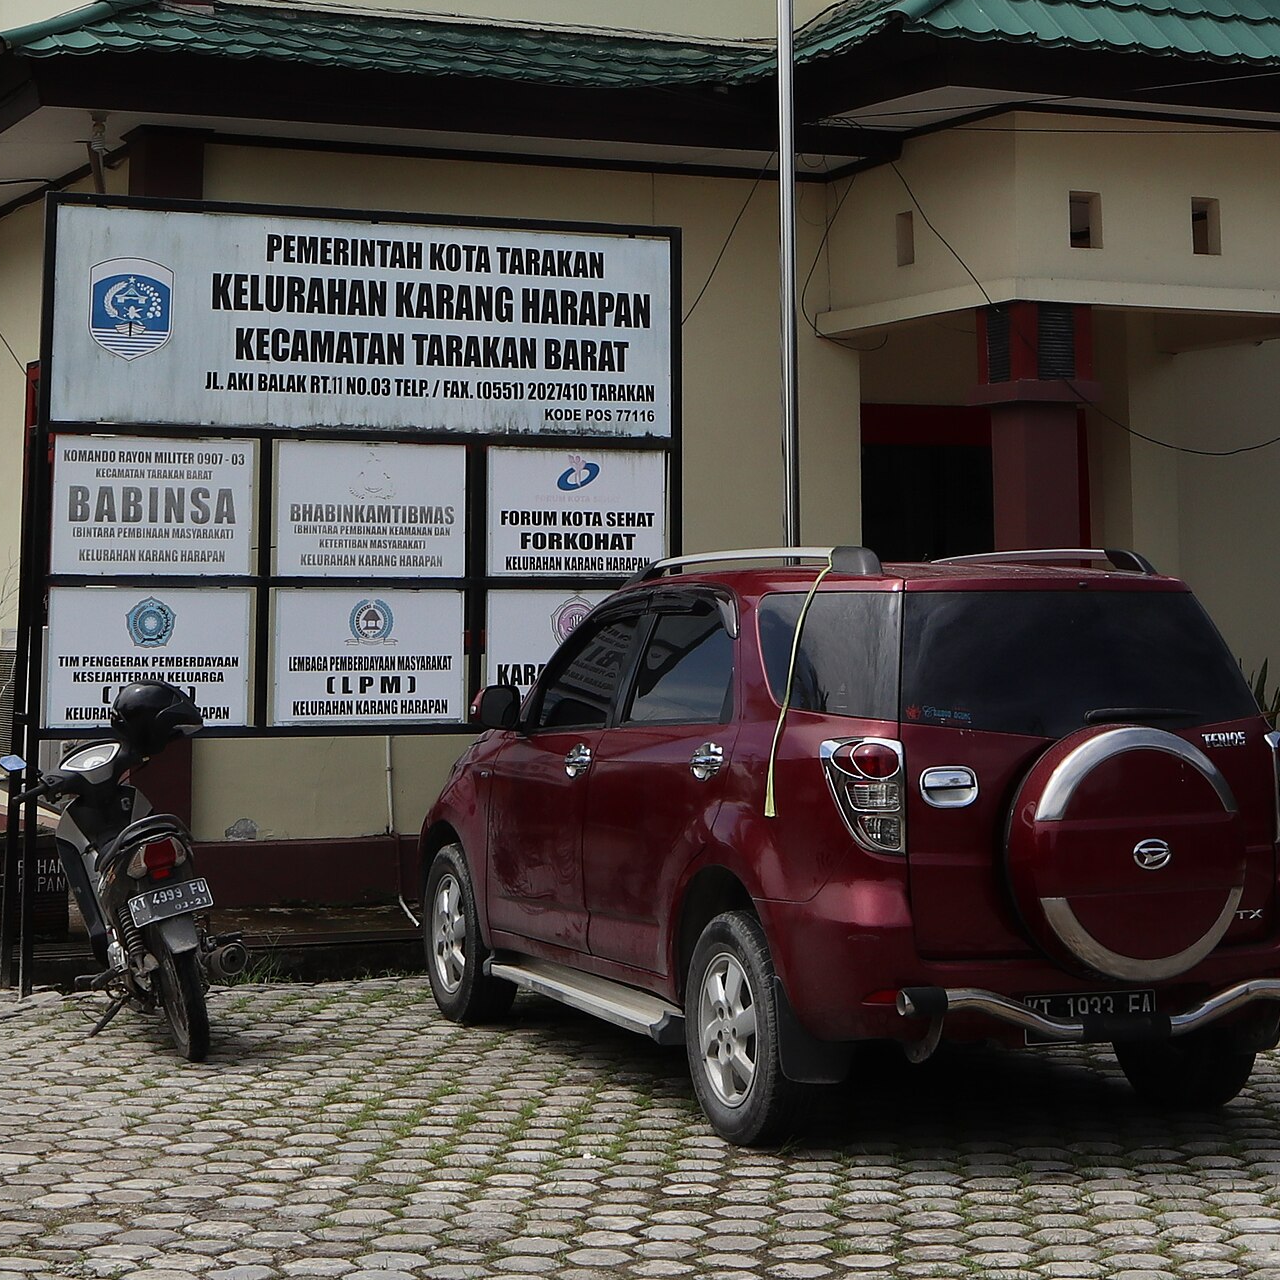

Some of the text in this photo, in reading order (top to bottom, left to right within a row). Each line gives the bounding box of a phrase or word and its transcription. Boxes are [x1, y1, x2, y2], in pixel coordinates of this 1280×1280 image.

[267, 234, 604, 278] PEMERINTAH KOTA TARAKAN
[212, 273, 651, 328] KELURAHAN KARANG HARAPAN
[235, 327, 629, 372] KECAMATAN TARAKAN BARAT
[205, 372, 224, 389] JL.
[227, 372, 253, 391] AKI
[258, 373, 307, 392] BALAK
[310, 375, 342, 394] RT.11
[346, 377, 390, 396] NO.03
[395, 378, 429, 397] TELP.
[443, 380, 473, 399] FAX.
[476, 381, 524, 400] (0551)
[527, 382, 587, 401] 2027410
[591, 383, 654, 402] TARAKAN
[544, 408, 654, 422] KODE POS 77116
[63, 449, 115, 462] KOMANDO
[118, 450, 151, 463] RAYON
[154, 451, 194, 464] MILITER
[197, 452, 223, 465] 0907
[231, 453, 245, 465] 03
[95, 467, 212, 480] KECAMATAN TARAKAN BARAT
[68, 485, 236, 524] BABINSA
[290, 503, 455, 525] BHABINKAMTIBMAS
[501, 510, 655, 527] FORUM KOTA SEHAT
[73, 526, 234, 540] (BINTARA PEMBINAAN MASYARAKAT)
[294, 524, 450, 536] (BHINTARA PEMBINAAN KEAMANAN DAN
[319, 538, 426, 550] KETERTIBAN MASYARAKAT)
[520, 532, 636, 551] FORKOHAT
[79, 548, 225, 563] KELURAHAN KARANG HARAPAN
[301, 553, 443, 568] KELURAHAN KARANG HARAPAN
[505, 555, 562, 571] KELURAHAN
[564, 556, 604, 571] KARANG
[58, 655, 239, 668] TIM PENGGERAK PEMBERDAYAAN
[288, 655, 453, 672] LEMBAGA PEMBERDAYAAN MASYARAKAT
[73, 671, 224, 683] KESEJAHTERAAN KELUARGA
[293, 699, 448, 716] KELURAHAN KARANG HARAPAN
[130, 881, 206, 913] KT 4999 FU
[1236, 909, 1264, 919] TX
